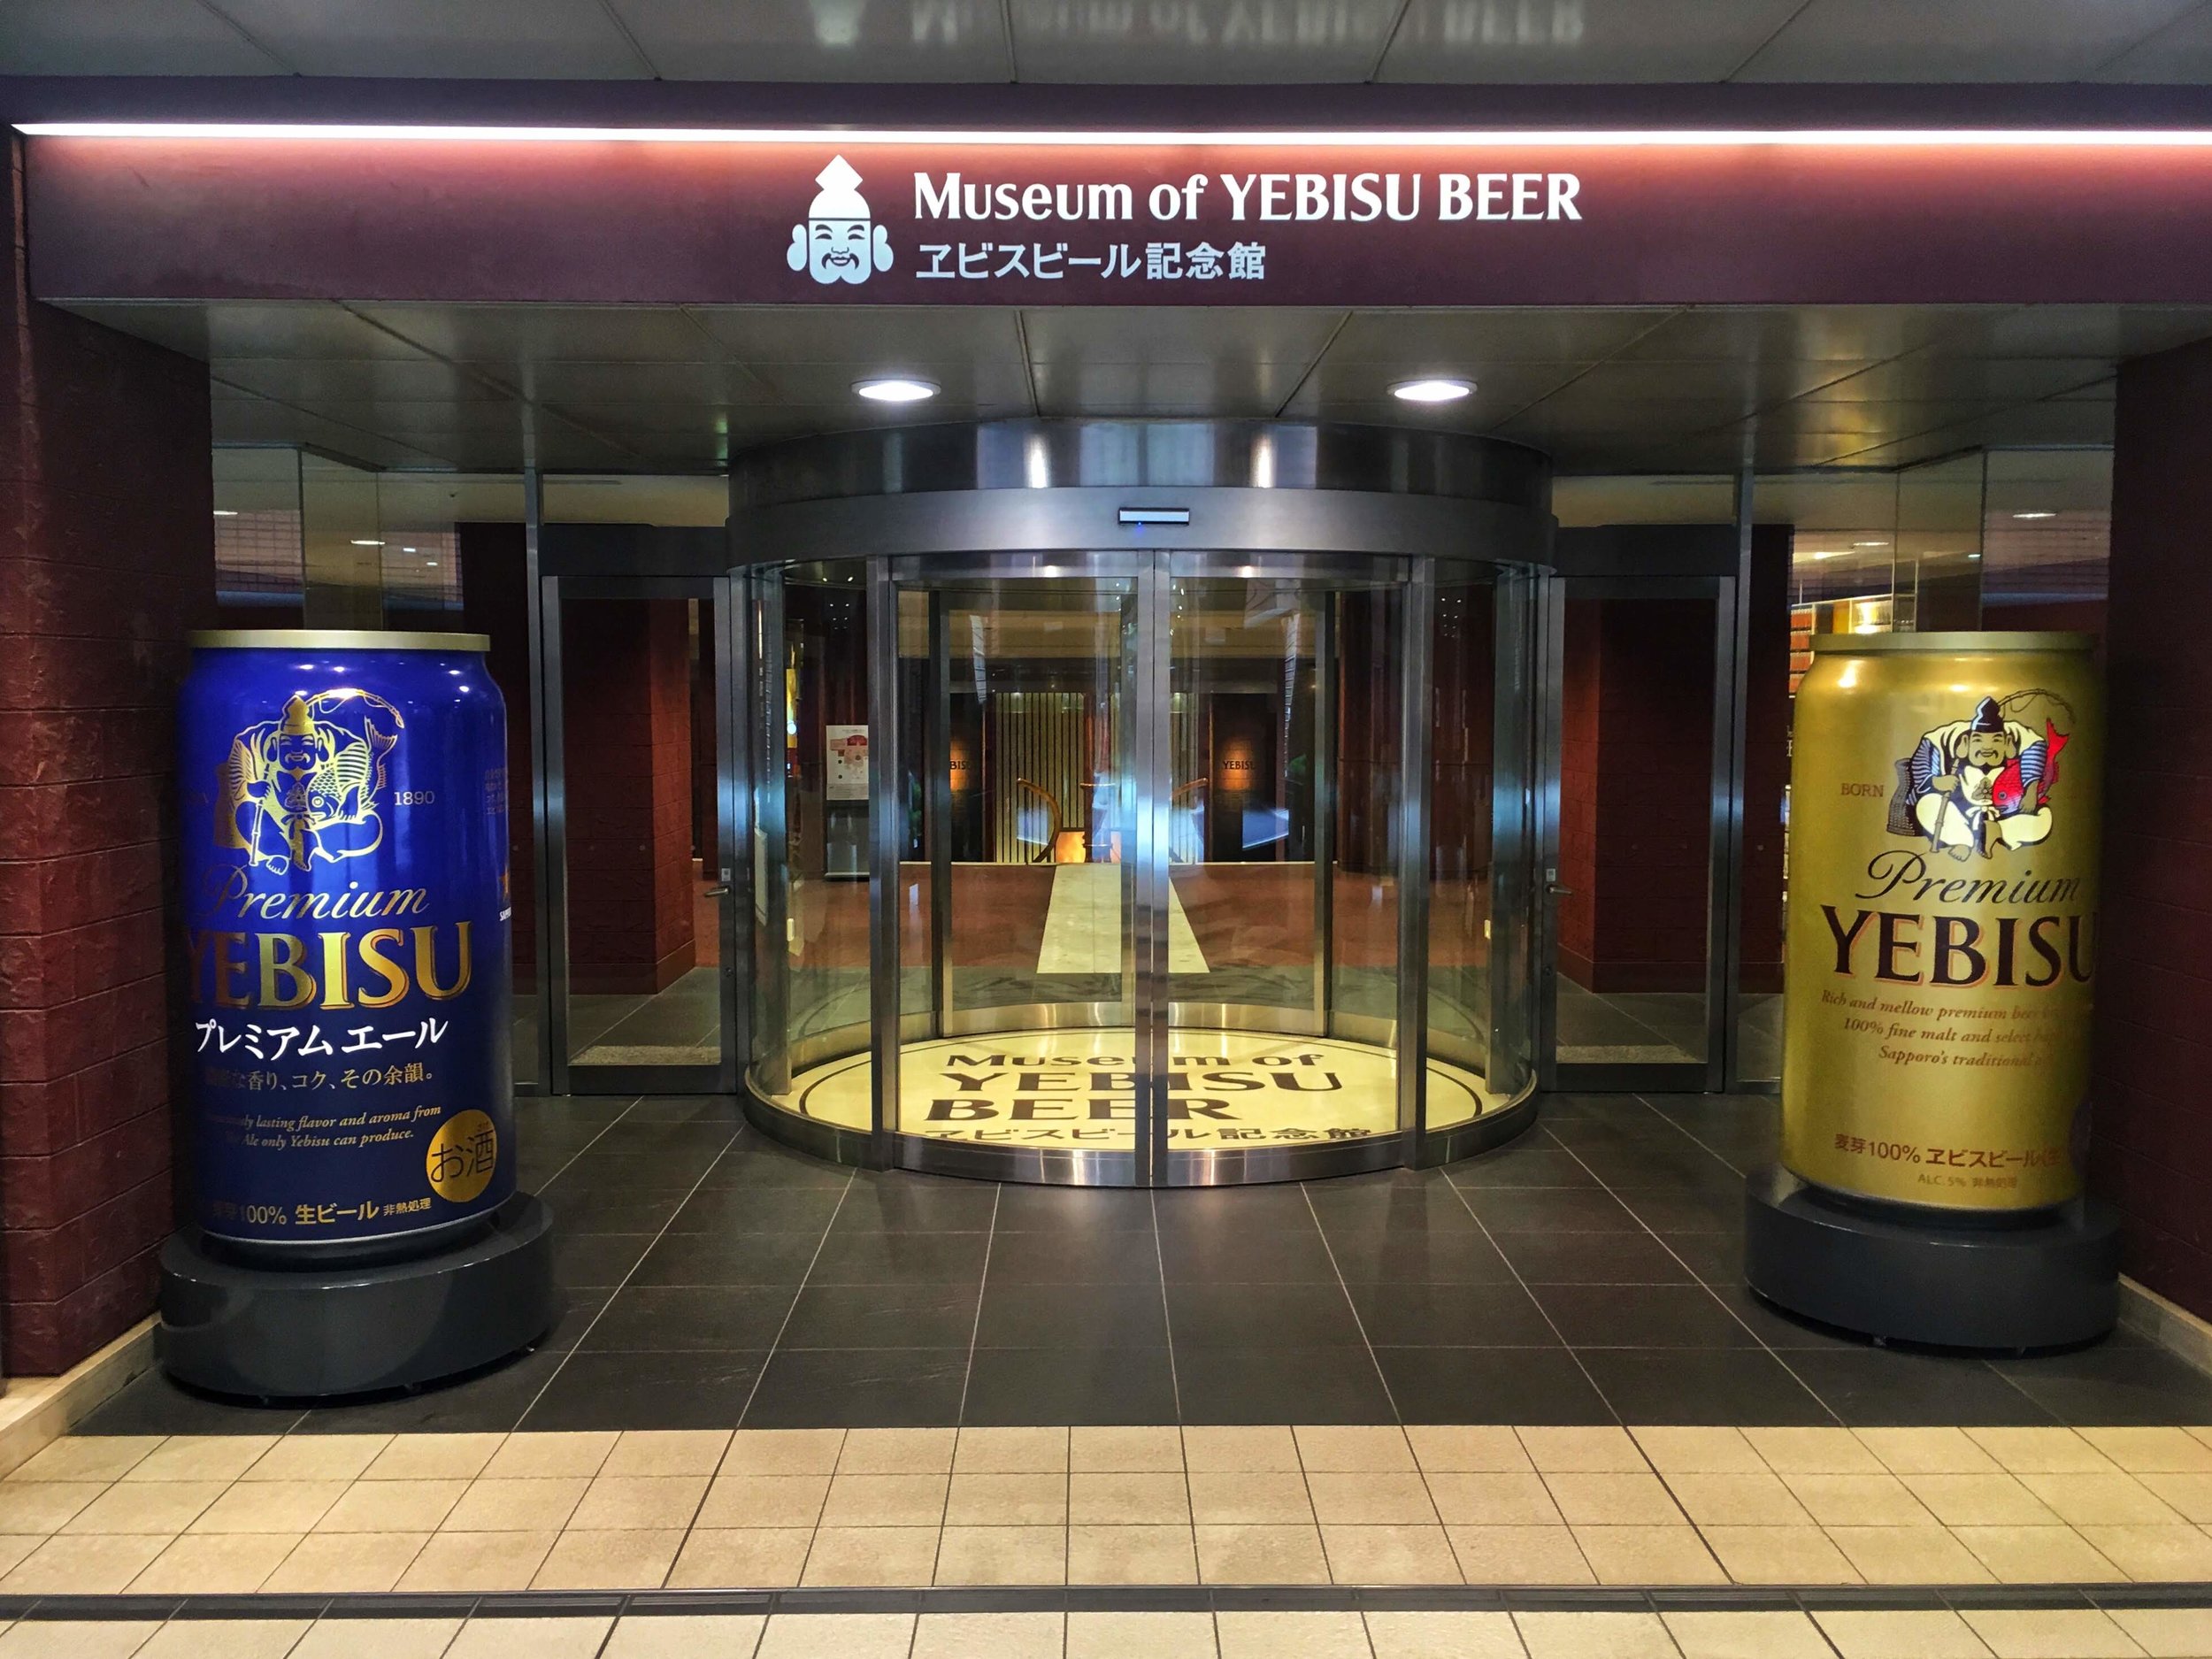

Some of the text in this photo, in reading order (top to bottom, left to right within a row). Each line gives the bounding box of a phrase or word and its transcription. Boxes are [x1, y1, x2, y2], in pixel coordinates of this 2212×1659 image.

[913, 171, 1582, 222] Museum of YEBISU BEER
[915, 242, 1267, 281] ヱビスビール記念館
[394, 790, 435, 807] 1890
[1840, 782, 1885, 798] BORN
[1855, 849, 2079, 905] Premium
[196, 863, 430, 920] Premium
[1820, 903, 2099, 991] YEBISU
[183, 921, 472, 1011] YEBISU
[1821, 989, 1847, 1006] Rich
[1849, 997, 1877, 1010] and
[1879, 1001, 1933, 1017] mellow
[1936, 1007, 2007, 1021] premium
[195, 1017, 449, 1061] プレミアム エール
[1844, 1018, 1884, 1035] 100%
[1886, 1023, 1916, 1040] fine
[1921, 1027, 1956, 1041] malt
[1961, 1029, 1991, 1043] and
[947, 1053, 1325, 1067] Musem of
[1878, 1045, 1948, 1066] Sapporo's
[940, 1071, 1343, 1092] YEBISU
[256, 1115, 296, 1133] lasting
[296, 1114, 336, 1132] flavor
[339, 1112, 366, 1126] and
[369, 1110, 411, 1125] aroma
[411, 1105, 442, 1123] from
[924, 1098, 1242, 1121] BEER
[261, 1133, 287, 1151] only
[290, 1133, 330, 1148] Yebisu
[334, 1134, 357, 1147] can
[360, 1128, 414, 1148] produce.
[431, 1130, 495, 1183] お酒
[296, 1199, 380, 1225] 生ビール
[382, 1197, 432, 1217] 非熱処理
